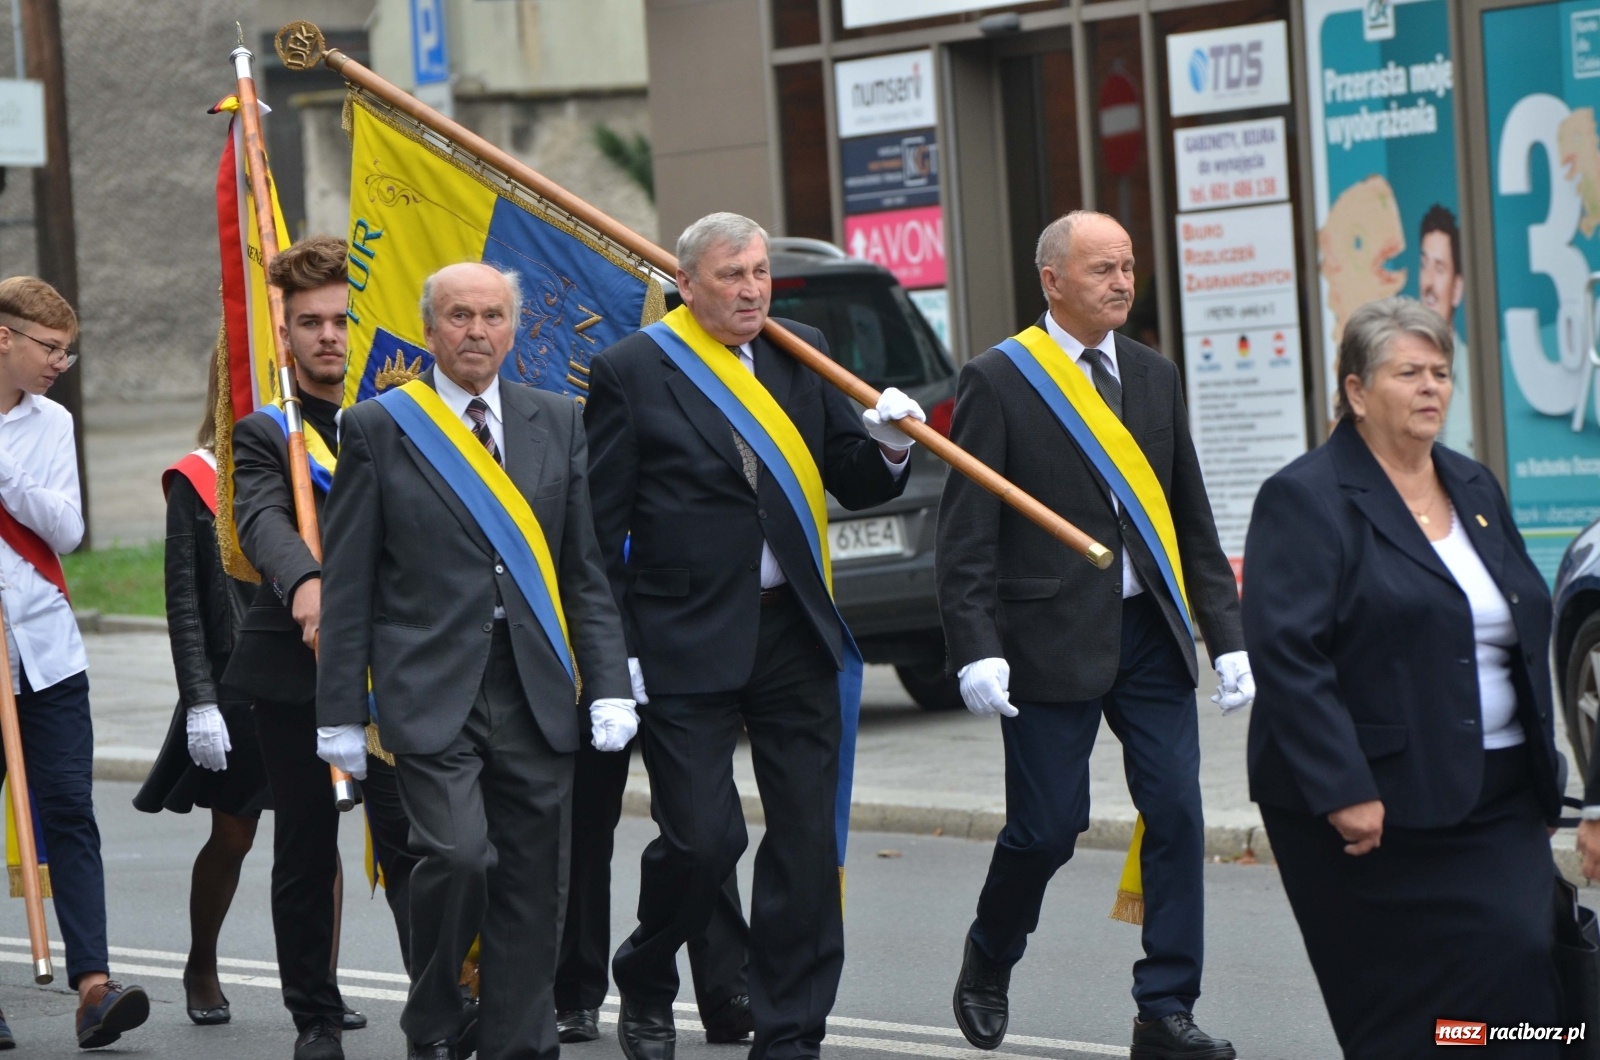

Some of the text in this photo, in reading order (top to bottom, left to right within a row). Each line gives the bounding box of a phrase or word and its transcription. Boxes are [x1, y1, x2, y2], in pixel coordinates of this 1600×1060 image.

[1209, 41, 1264, 92] TDS
[1324, 61, 1408, 103] Przerasta
[1326, 98, 1438, 150] wyobrażenia
[869, 218, 944, 266] AVON
[836, 520, 896, 551] 6XE4
